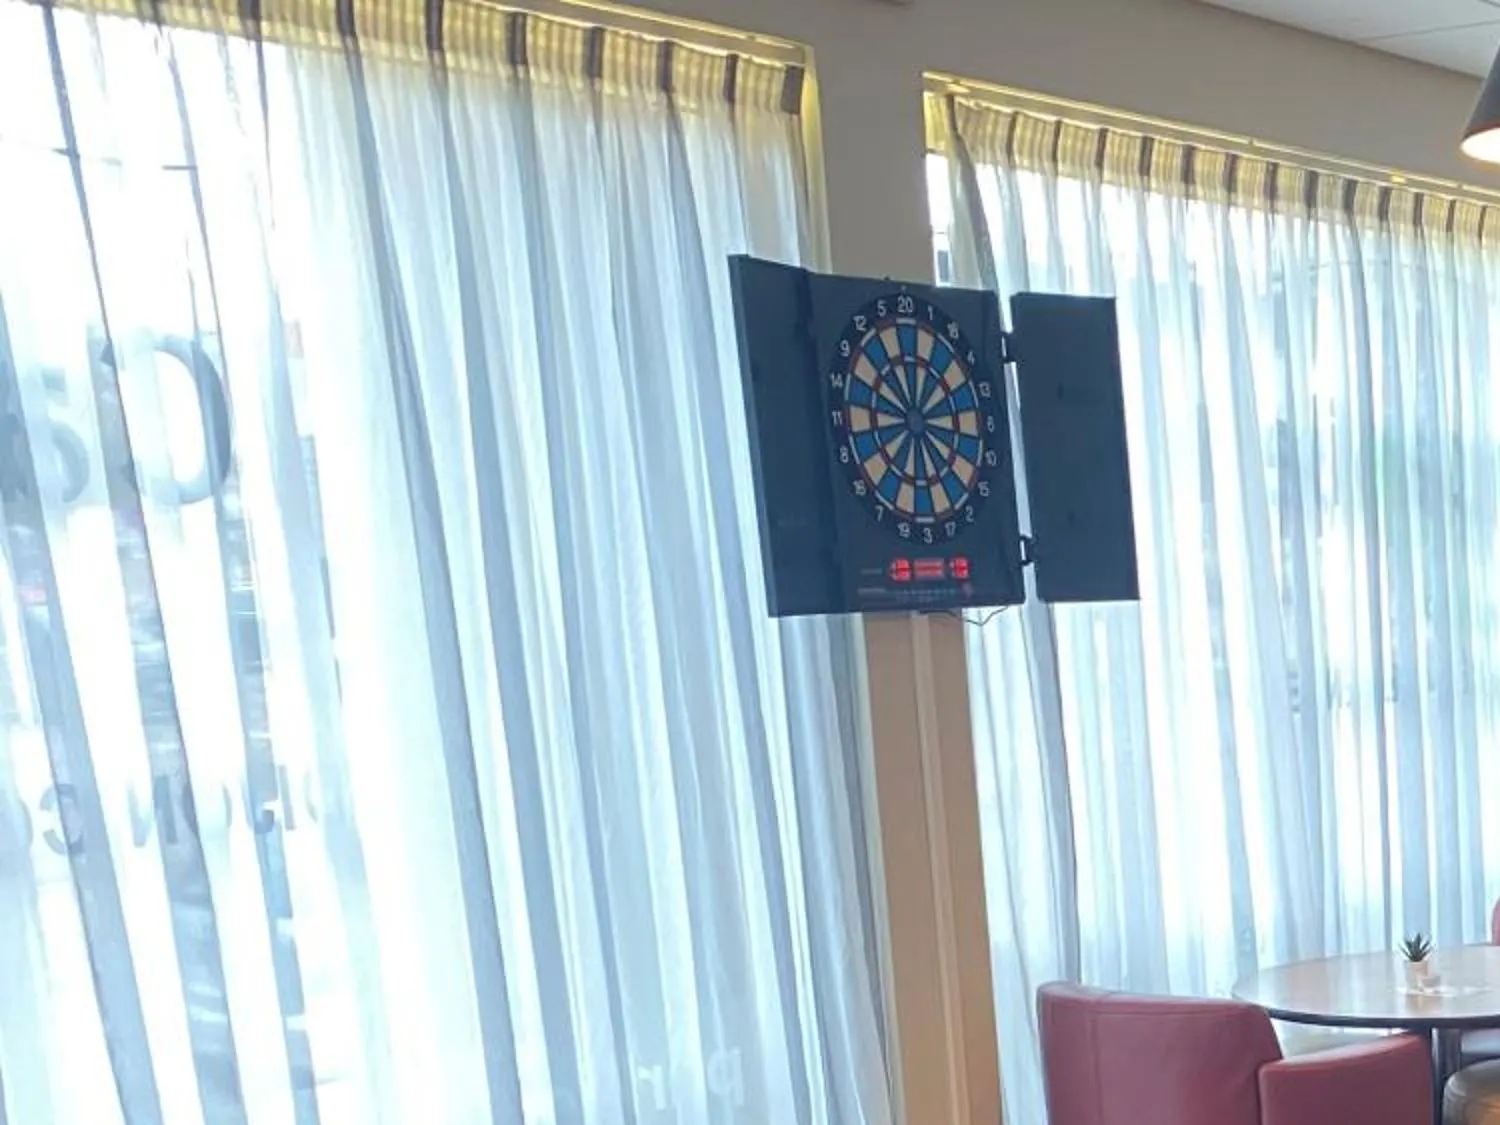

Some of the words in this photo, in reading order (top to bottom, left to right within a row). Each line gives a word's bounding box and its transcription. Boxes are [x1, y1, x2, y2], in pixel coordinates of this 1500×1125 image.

[877, 300, 887, 317] 5
[897, 296, 914, 313] 20
[927, 305, 934, 321] 1
[853, 315, 867, 332] 12
[840, 340, 850, 357] 9
[967, 351, 976, 364] 4
[830, 373, 843, 387] 14
[978, 382, 991, 398] 13
[832, 411, 843, 425] 11
[839, 447, 849, 463] 8
[984, 451, 997, 466] 10
[875, 505, 884, 522] 7
[965, 505, 974, 522] 2
[898, 522, 910, 538] 19
[924, 527, 933, 544] 3
[945, 521, 956, 537] 17
